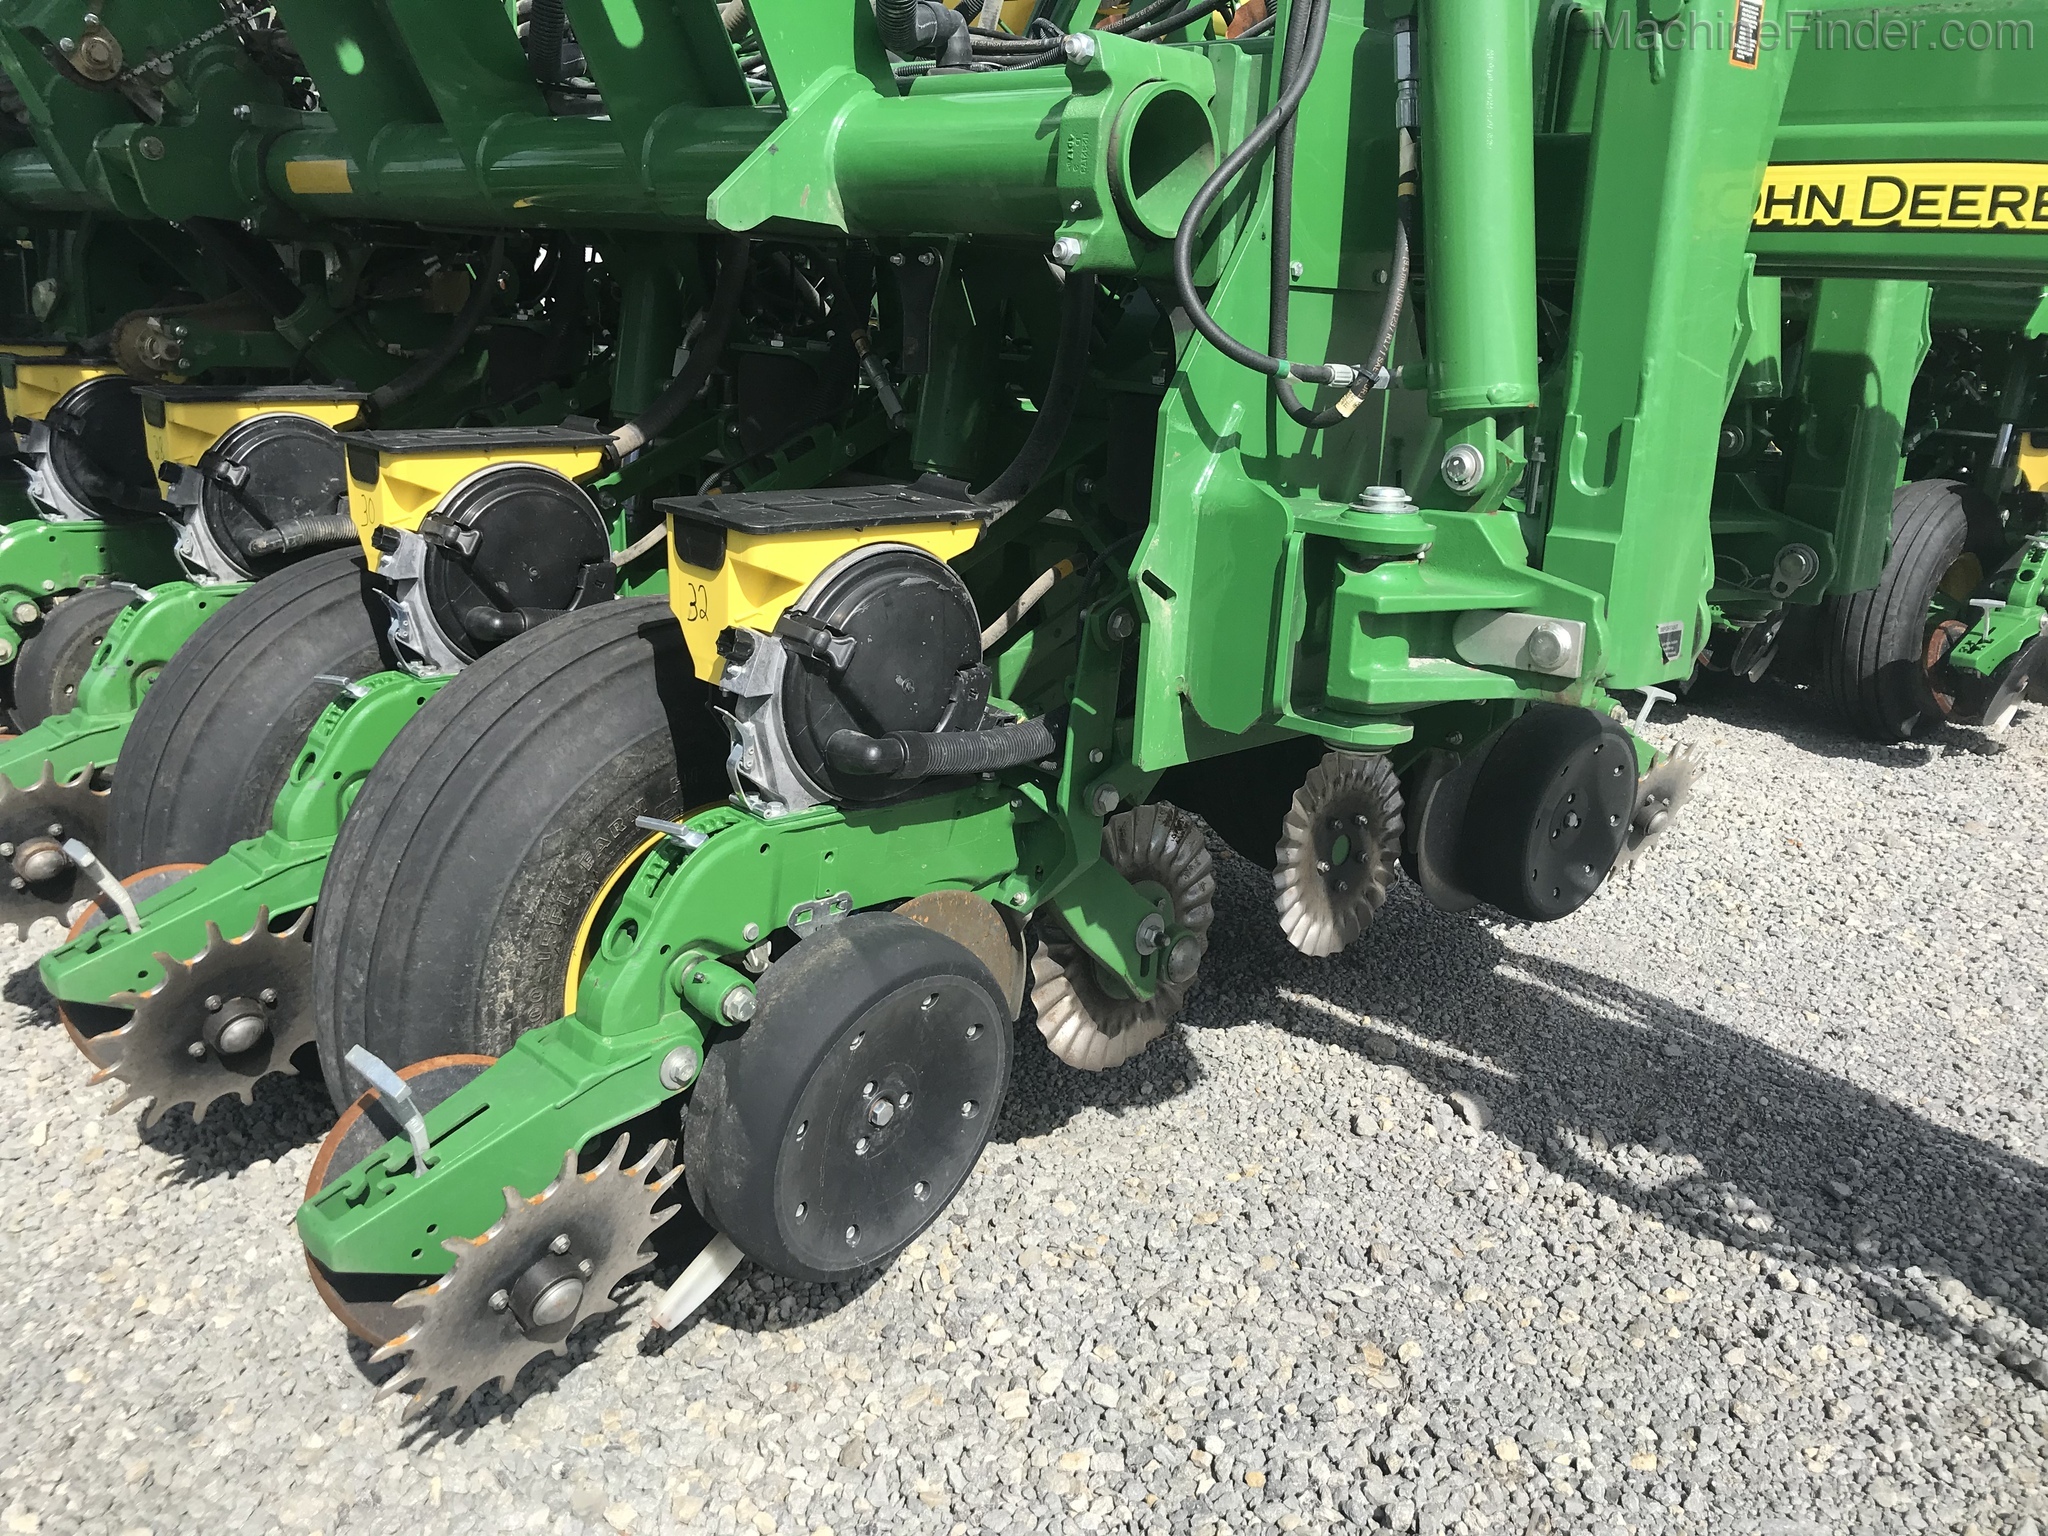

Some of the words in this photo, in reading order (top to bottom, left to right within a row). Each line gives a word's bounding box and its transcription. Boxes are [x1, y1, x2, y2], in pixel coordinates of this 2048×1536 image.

[1754, 184, 1846, 220] HN
[361, 494, 376, 527] 30
[687, 582, 709, 622] 32
[579, 797, 648, 872] FARM
